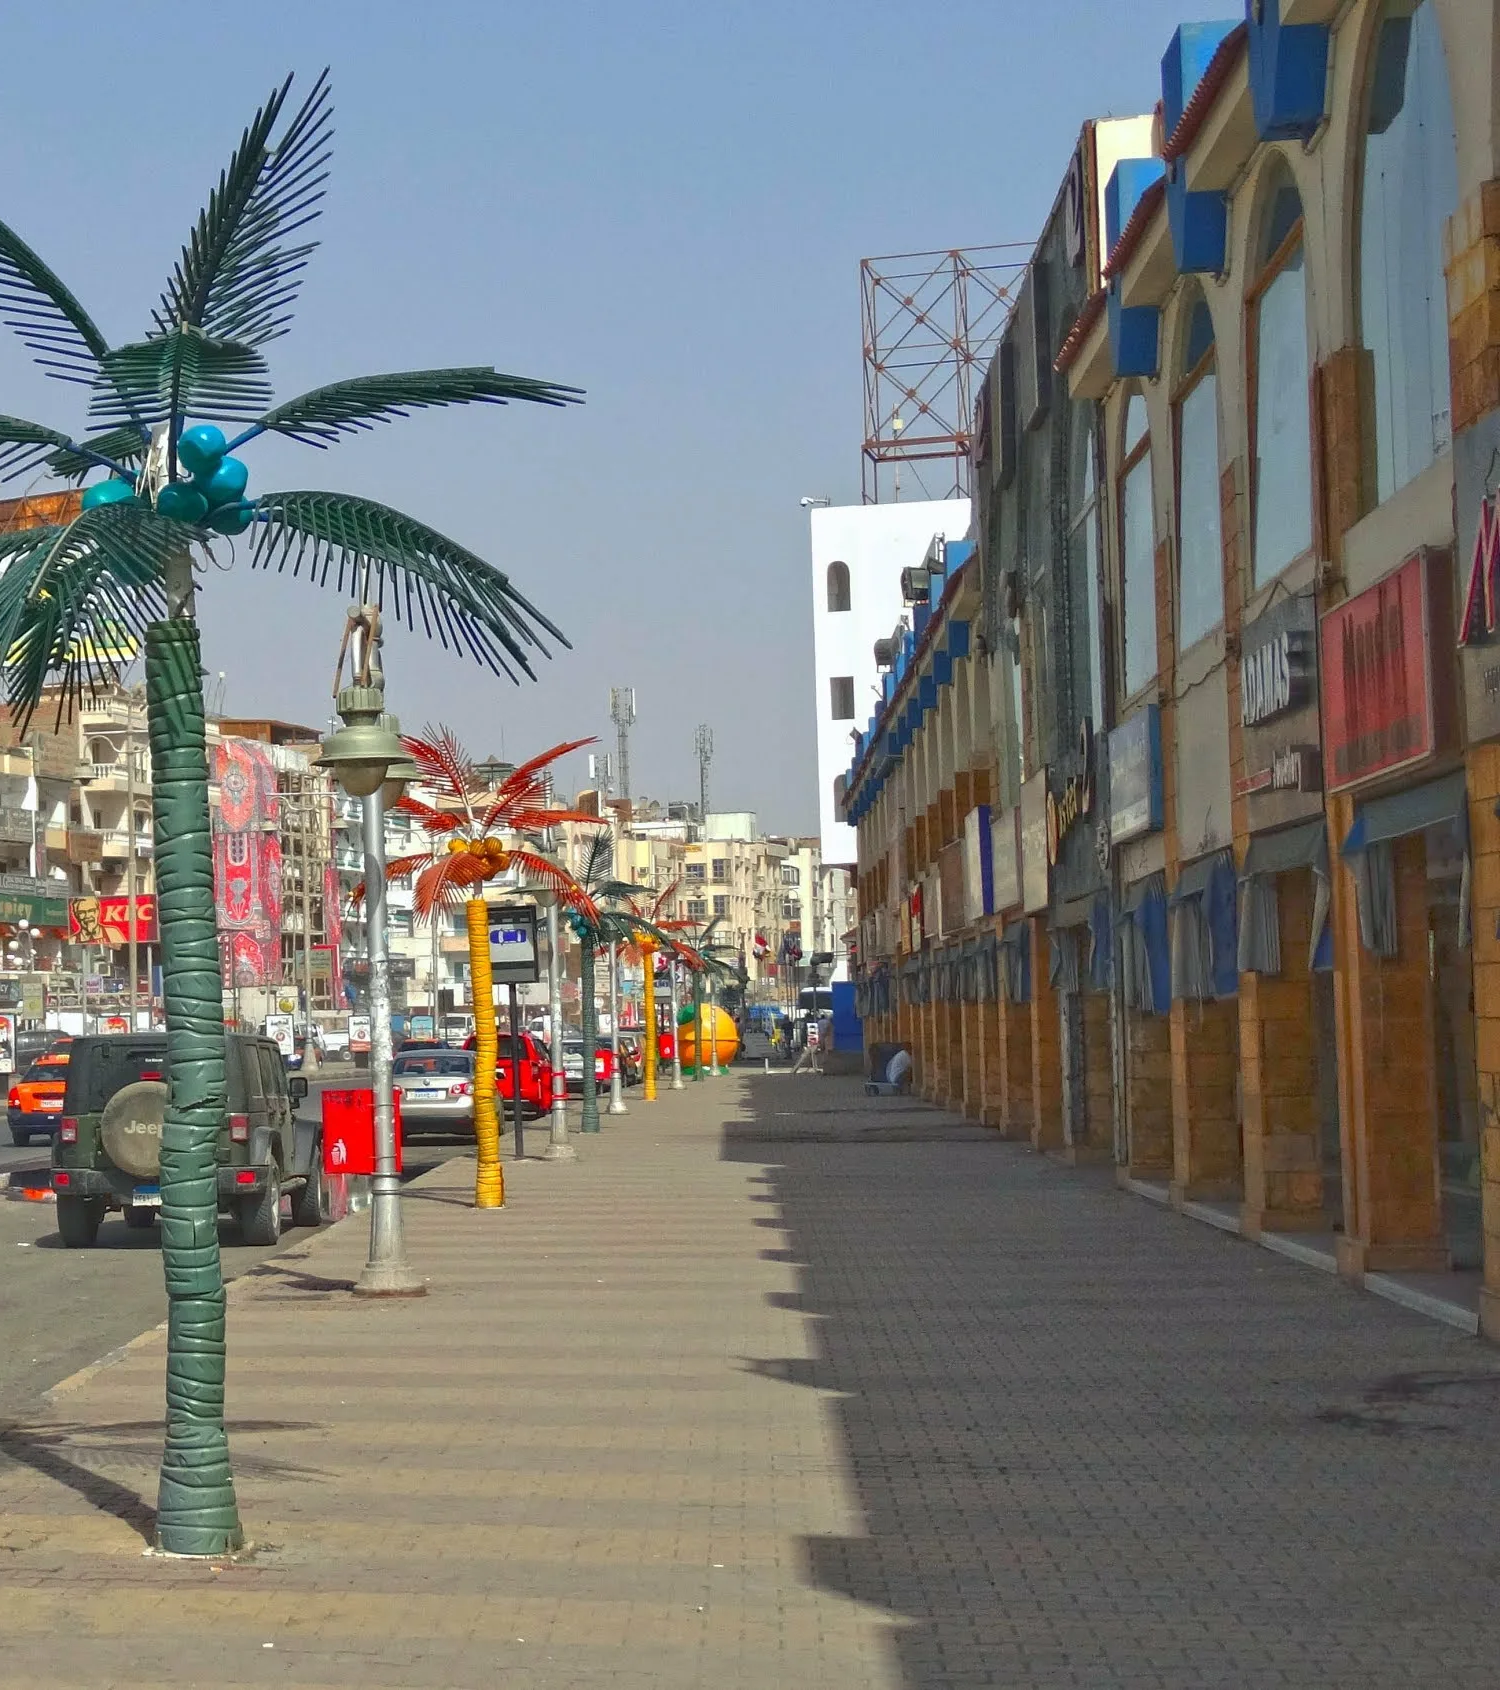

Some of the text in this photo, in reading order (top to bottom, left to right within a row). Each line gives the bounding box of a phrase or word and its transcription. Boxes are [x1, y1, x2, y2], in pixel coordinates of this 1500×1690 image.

[1241, 631, 1290, 728] ADAMAS
[223, 935, 231, 988] SILVER
[124, 1121, 164, 1139] Jeep
